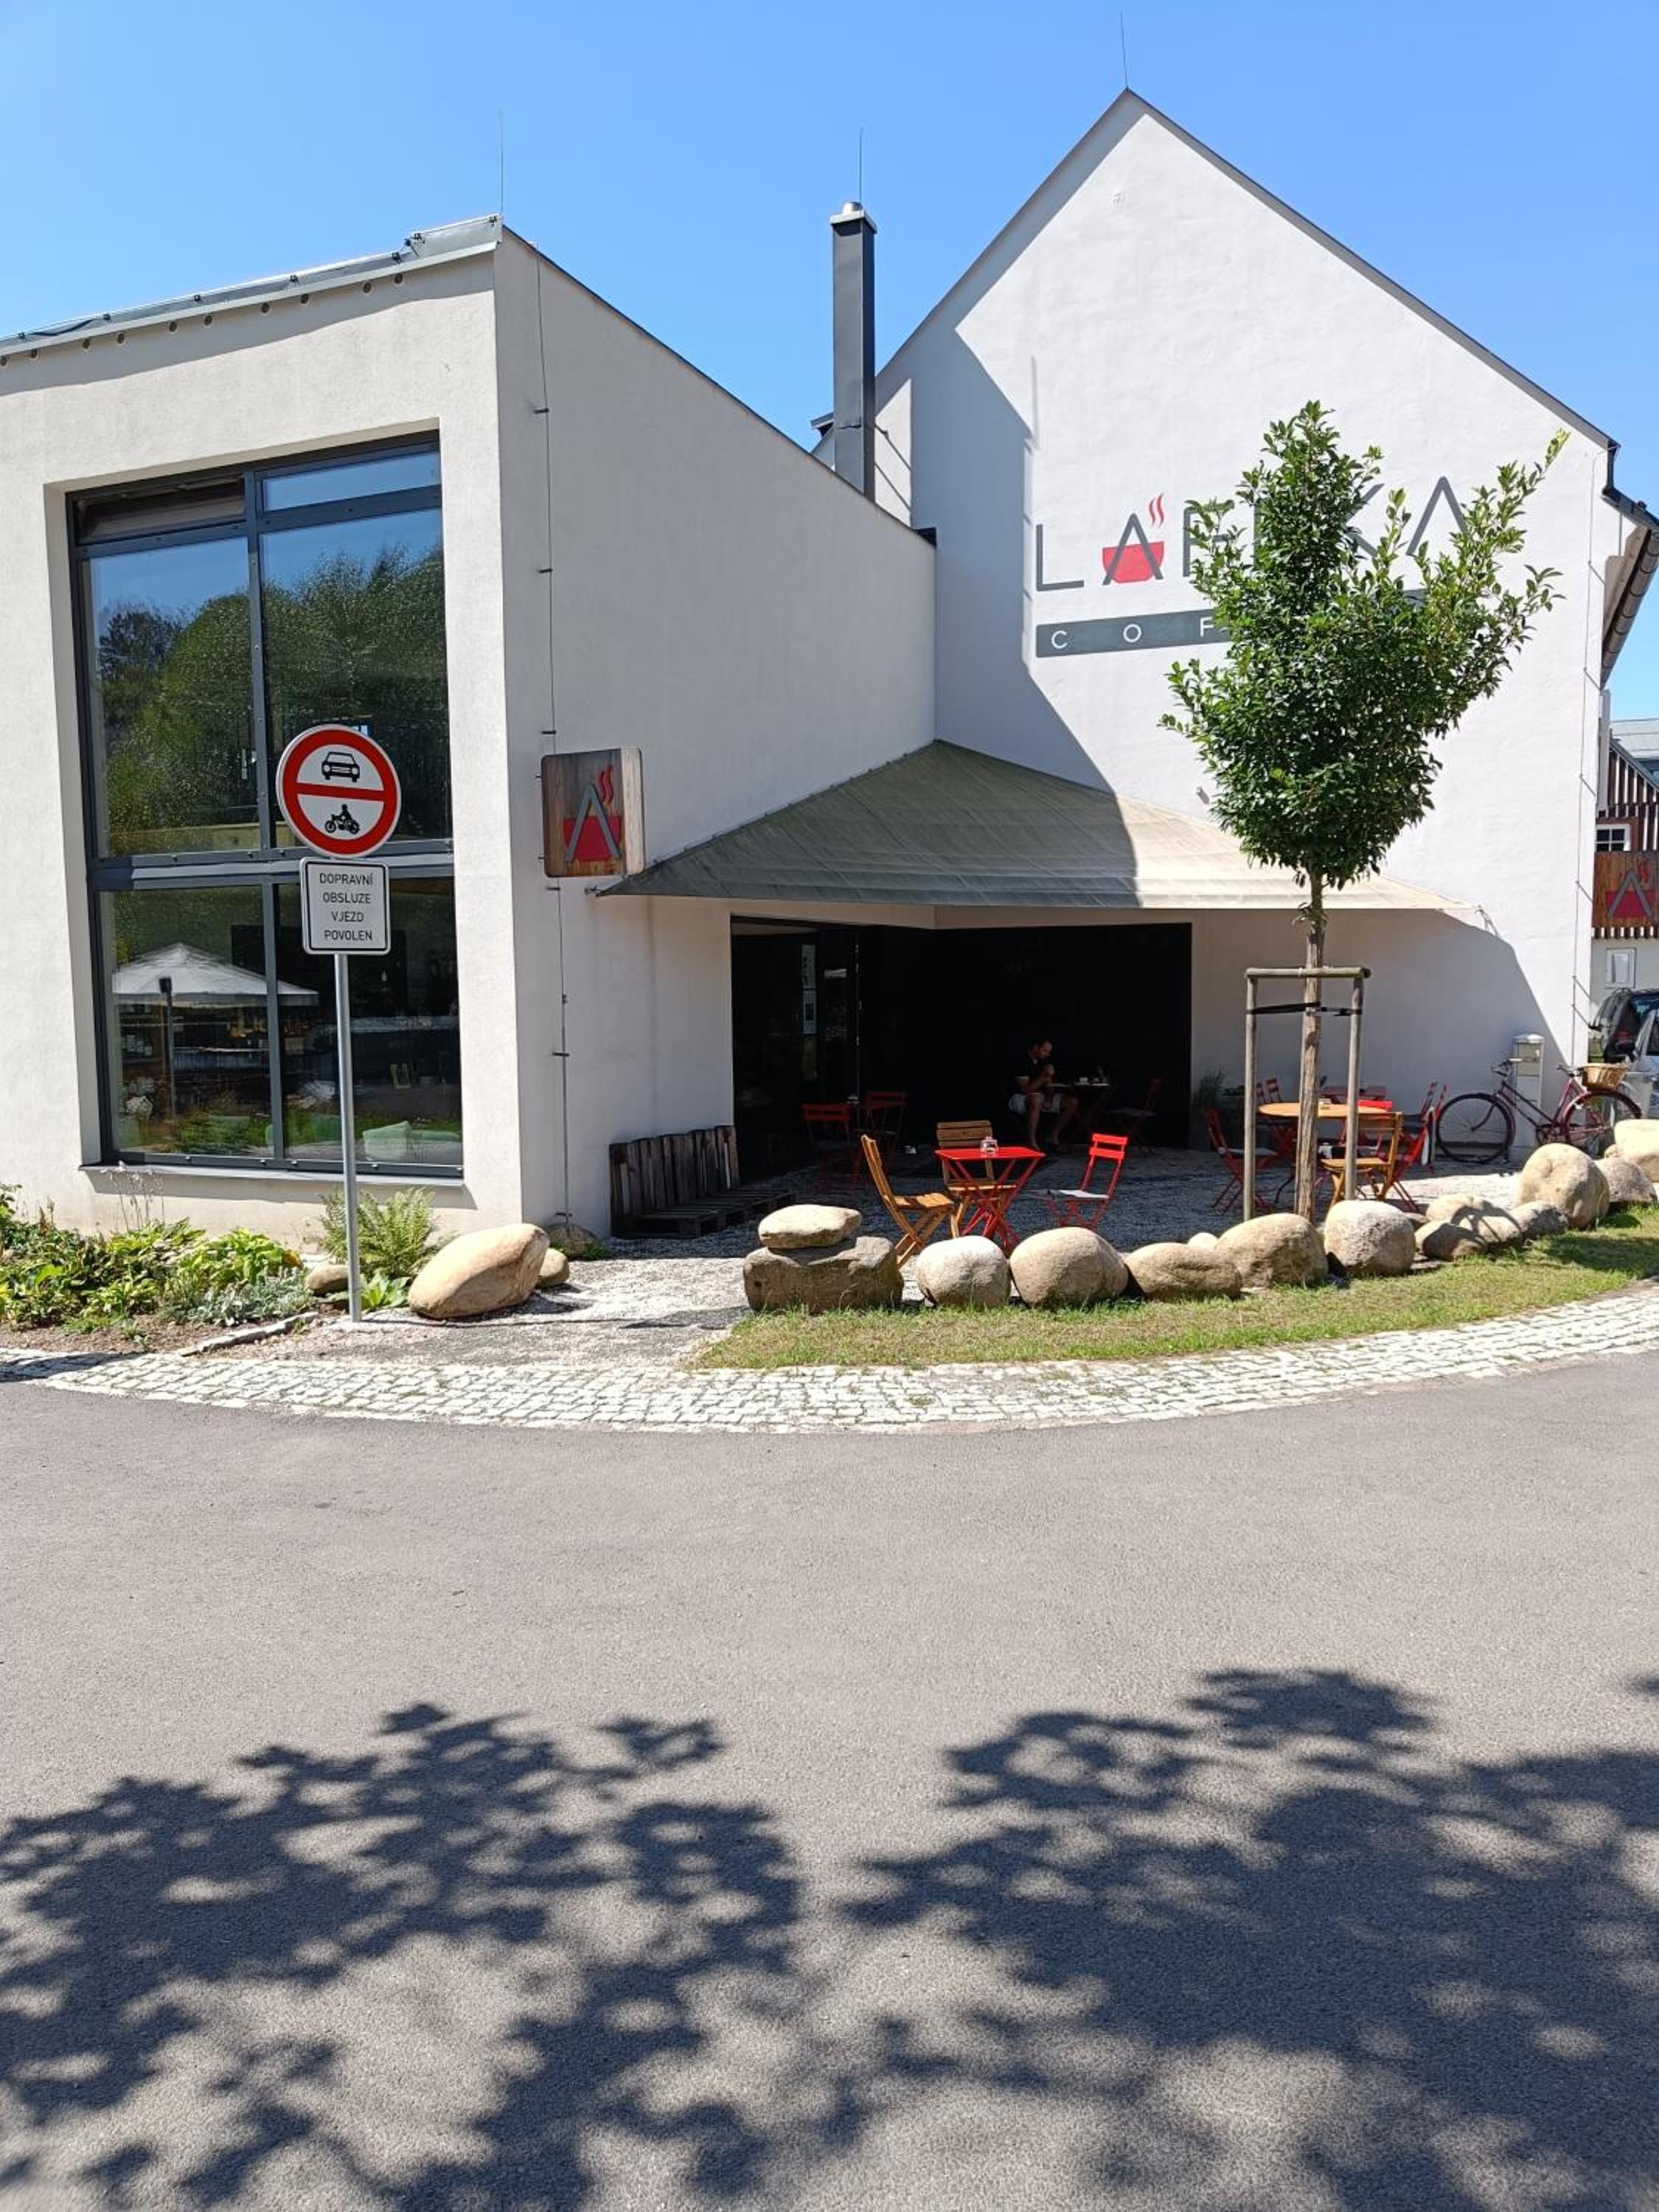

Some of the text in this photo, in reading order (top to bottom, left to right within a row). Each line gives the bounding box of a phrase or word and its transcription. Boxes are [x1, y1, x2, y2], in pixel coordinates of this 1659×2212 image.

[1035, 476, 1475, 592] LAFKA
[319, 872, 374, 885] DOPRAVNÍ
[322, 891, 372, 904] OBSLUZE
[331, 911, 364, 922] VJEZD
[324, 930, 372, 941] POVOLEN
